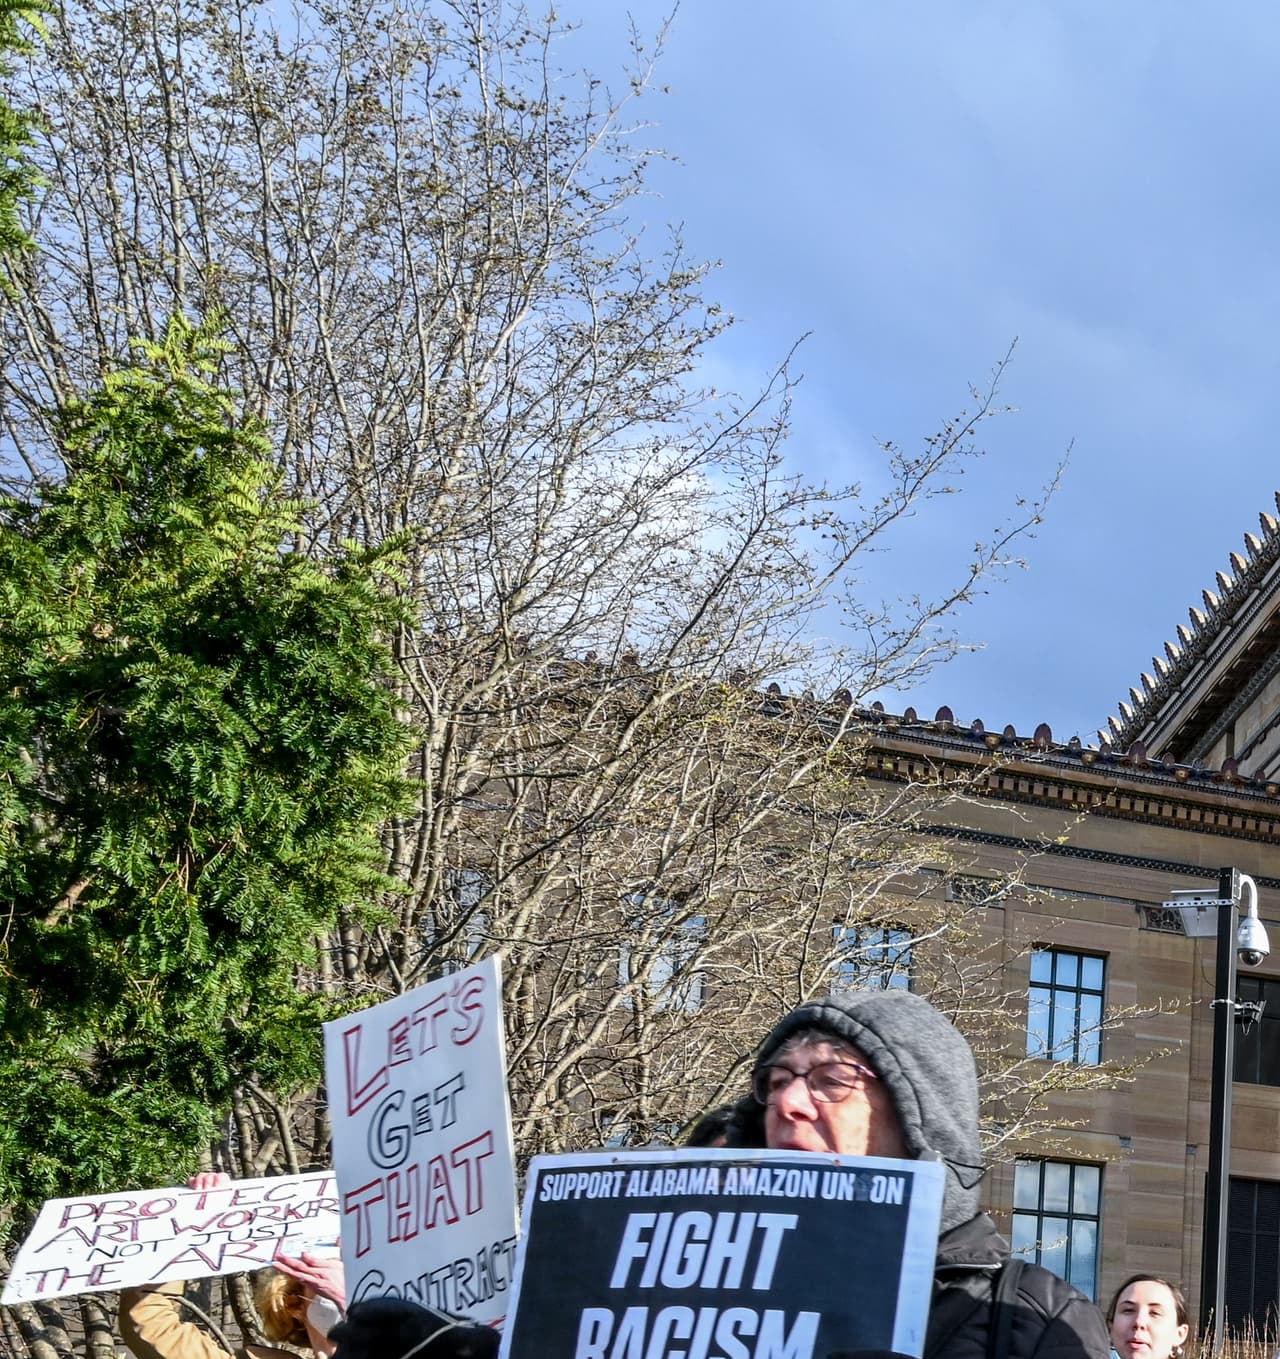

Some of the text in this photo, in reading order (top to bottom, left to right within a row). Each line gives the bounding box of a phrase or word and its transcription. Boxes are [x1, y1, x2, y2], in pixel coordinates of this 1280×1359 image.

[343, 976, 487, 1116] LET'S
[368, 1071, 465, 1170] GET
[58, 1177, 337, 1229] PROTECT
[344, 1130, 494, 1258] THAT
[540, 1172, 627, 1201] SUPPORT
[624, 1167, 717, 1199] ALABAMA
[722, 1166, 820, 1199] AMAZON
[34, 1198, 341, 1253] ART WORKER
[86, 1221, 303, 1262] NOT JUST
[609, 1211, 798, 1291] FIGHT
[26, 1261, 125, 1293] THE
